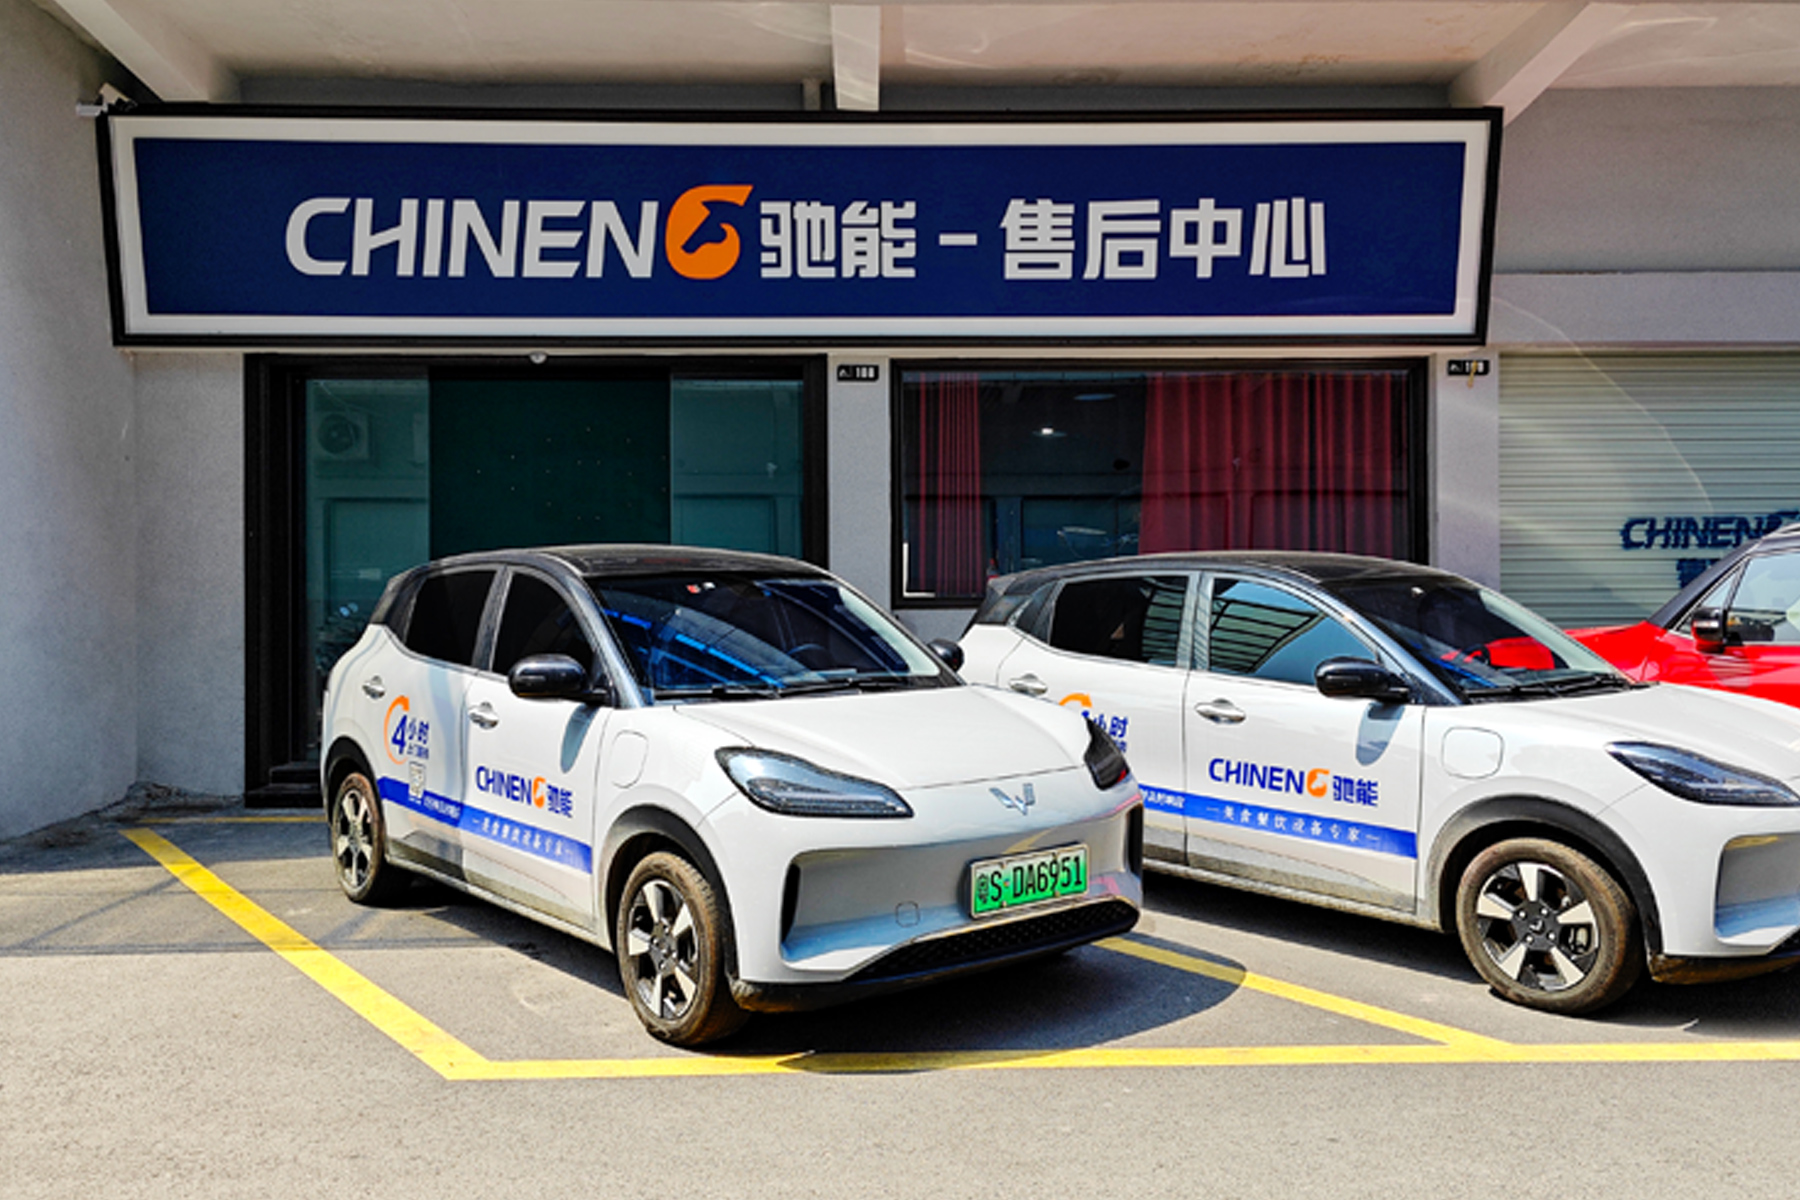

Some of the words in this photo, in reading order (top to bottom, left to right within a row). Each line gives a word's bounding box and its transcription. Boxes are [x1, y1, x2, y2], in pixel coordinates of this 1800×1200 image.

[760, 201, 917, 278] 驰能
[999, 197, 1326, 280] 售后中心
[1332, 775, 1379, 807] 驰能
